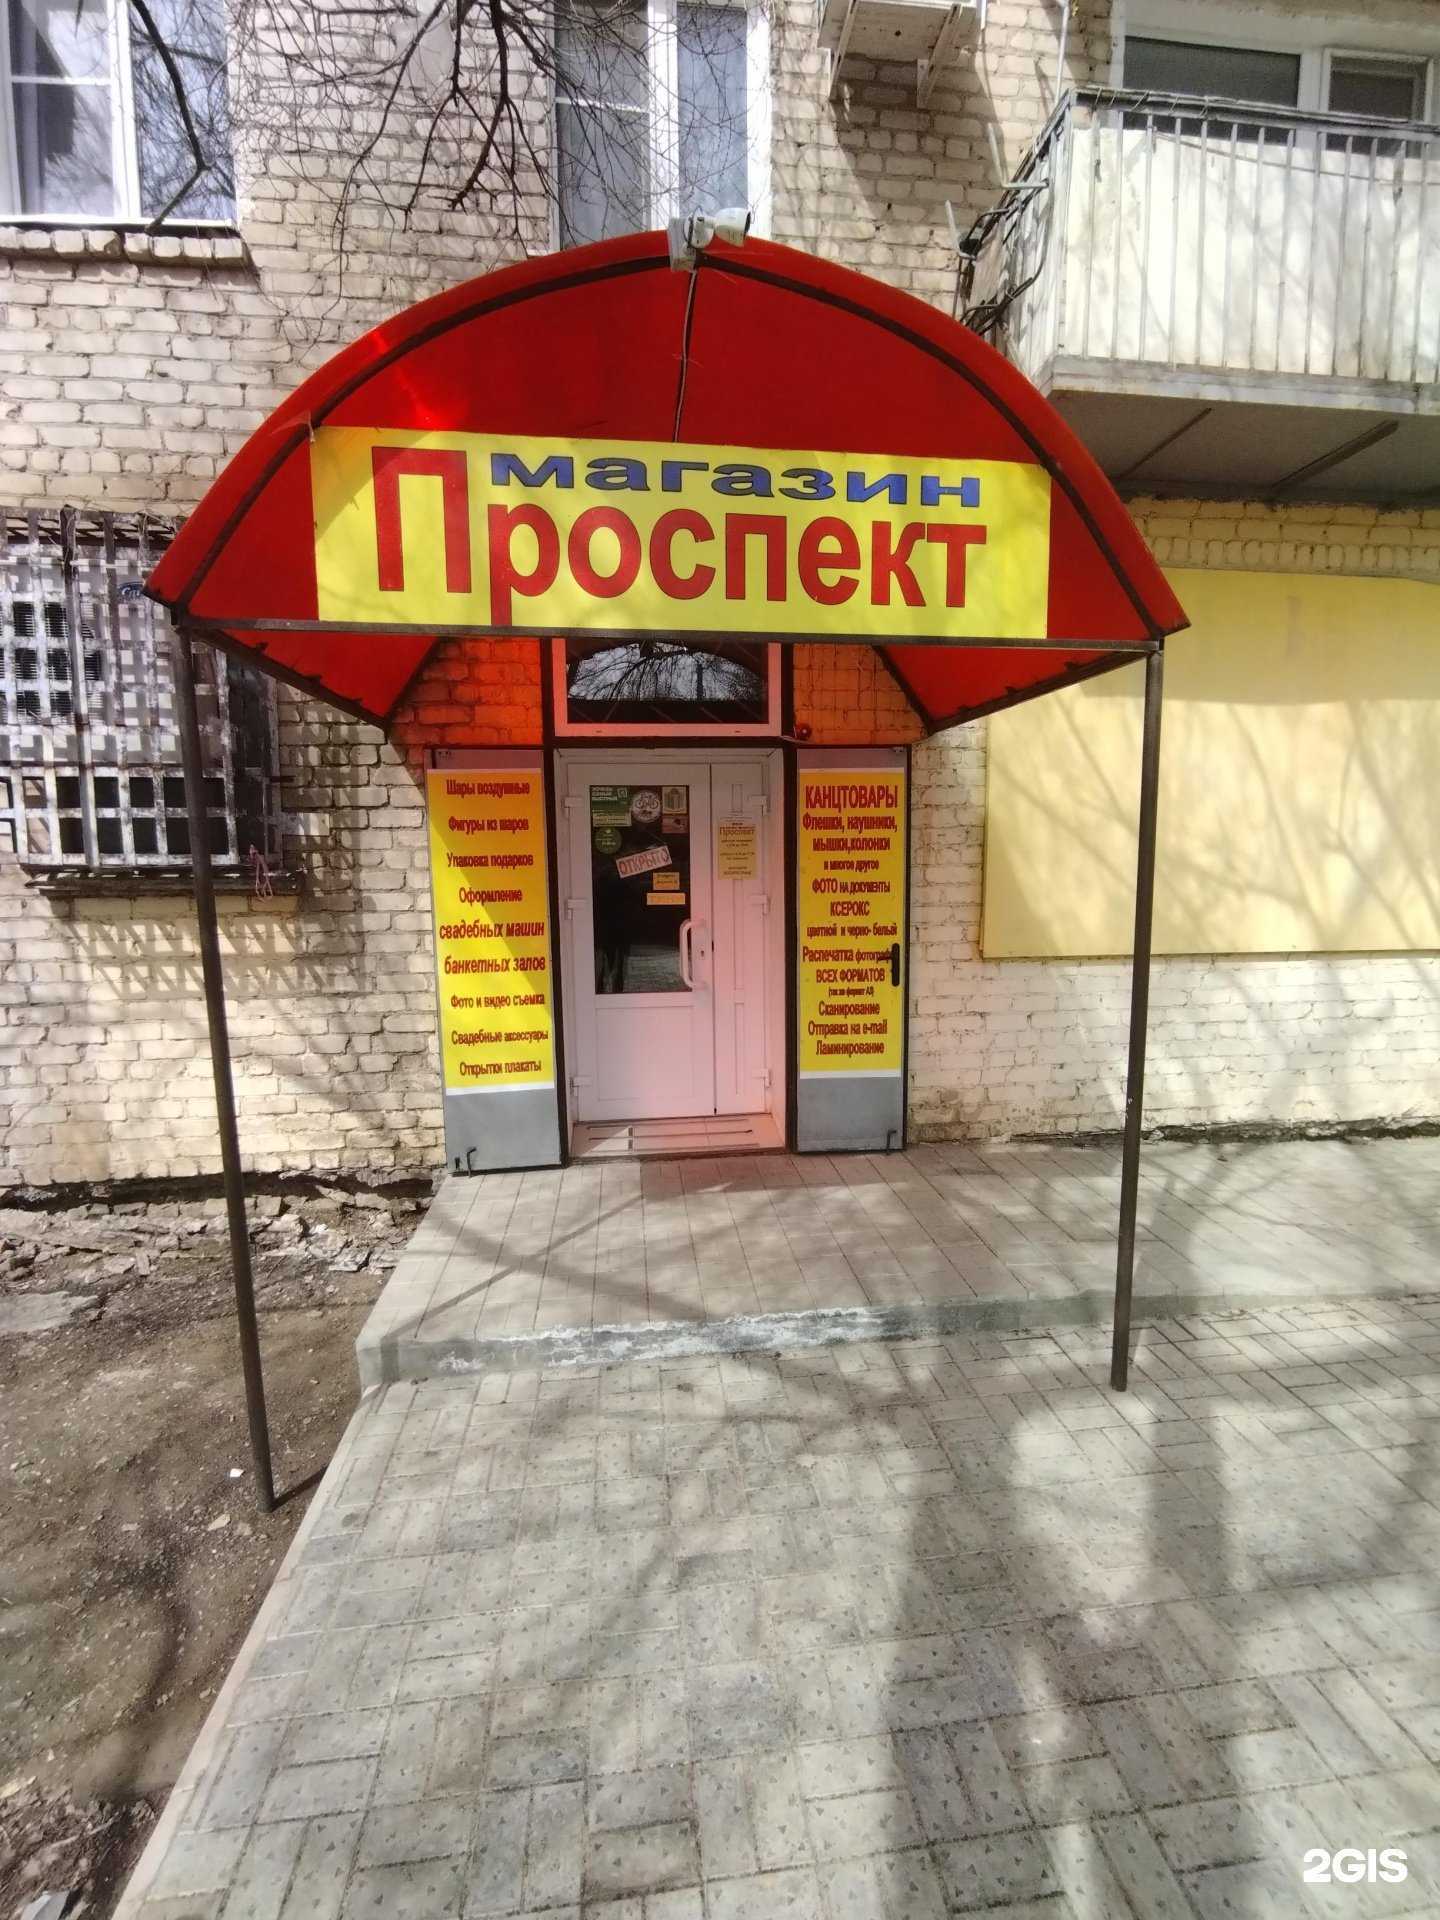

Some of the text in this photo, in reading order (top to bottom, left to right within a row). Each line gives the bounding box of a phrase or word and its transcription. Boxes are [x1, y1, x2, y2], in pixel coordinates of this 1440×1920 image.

[490, 452, 981, 508] магазин
[371, 446, 987, 626] Проспект
[446, 779, 475, 798] Шары
[805, 785, 898, 813] КАНЦТОВАРЫ
[448, 815, 529, 835] Фигуры из шаров
[447, 853, 534, 870] Упаковка подарков
[812, 878, 838, 894] ФОТО
[459, 887, 523, 906] Оформление
[830, 901, 871, 917] КСЕРОКС
[439, 918, 545, 940] свадебных машин
[806, 923, 837, 940] цветной
[802, 946, 854, 963] Распечатка
[444, 954, 546, 975] банкетных залов
[816, 967, 886, 983] ВСЕХ ФОРМАТОВ
[450, 995, 474, 1008] Фото
[476, 997, 483, 1008] и
[484, 994, 511, 1010] видео
[818, 1001, 881, 1019] Сканирование
[451, 1029, 549, 1047] Свадебные аксессуары
[808, 1020, 849, 1039] Отправка
[850, 1024, 861, 1034] на
[815, 1040, 885, 1058] Ламинирование
[504, 1060, 542, 1074] плакаты
